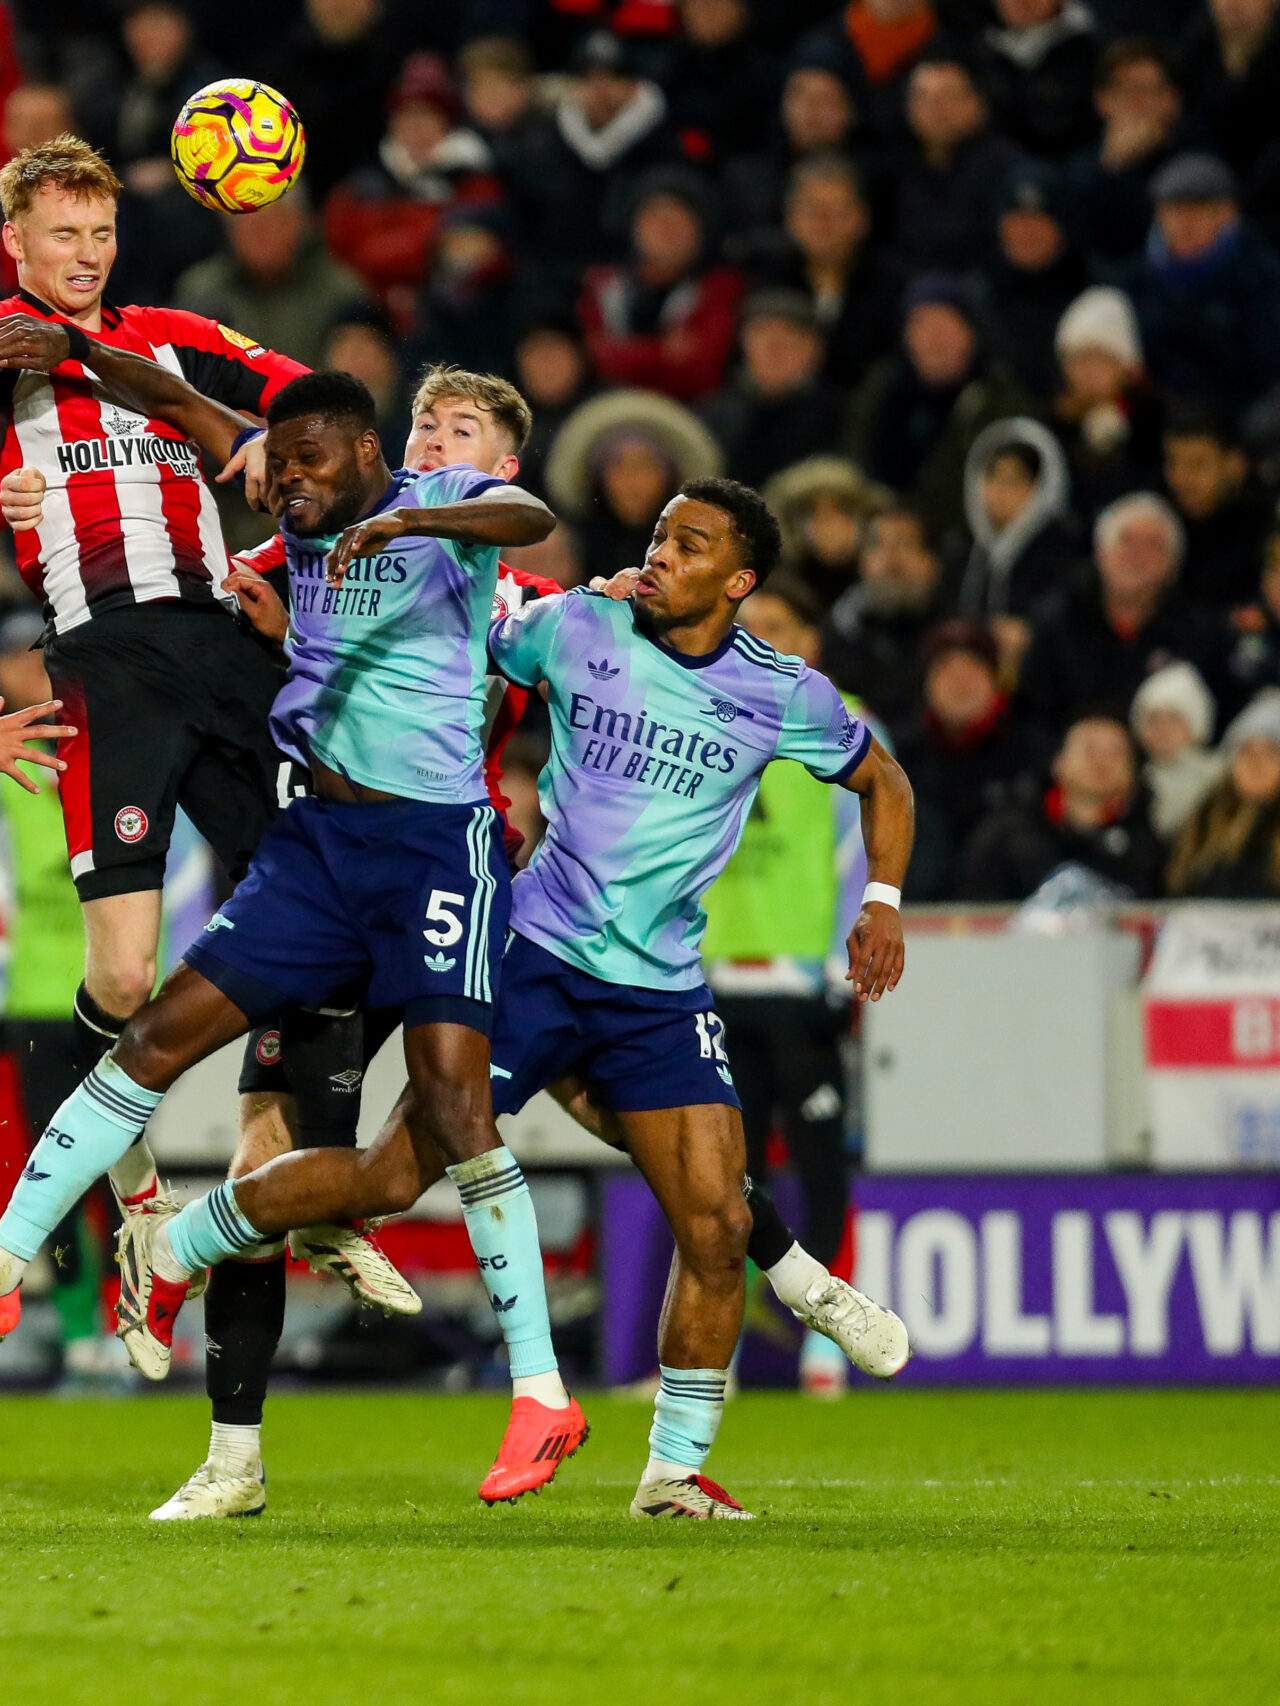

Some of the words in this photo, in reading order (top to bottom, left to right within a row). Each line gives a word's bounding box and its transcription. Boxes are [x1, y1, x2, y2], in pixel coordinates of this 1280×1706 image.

[295, 583, 320, 613] FLY
[321, 586, 382, 617] BETTER
[569, 692, 738, 774] Emirates
[581, 738, 622, 772] FLY
[622, 751, 705, 799] BETTER
[422, 888, 466, 947] 5
[694, 1010, 730, 1065] 12
[44, 1125, 76, 1150] FC
[476, 1253, 508, 1271] FC
